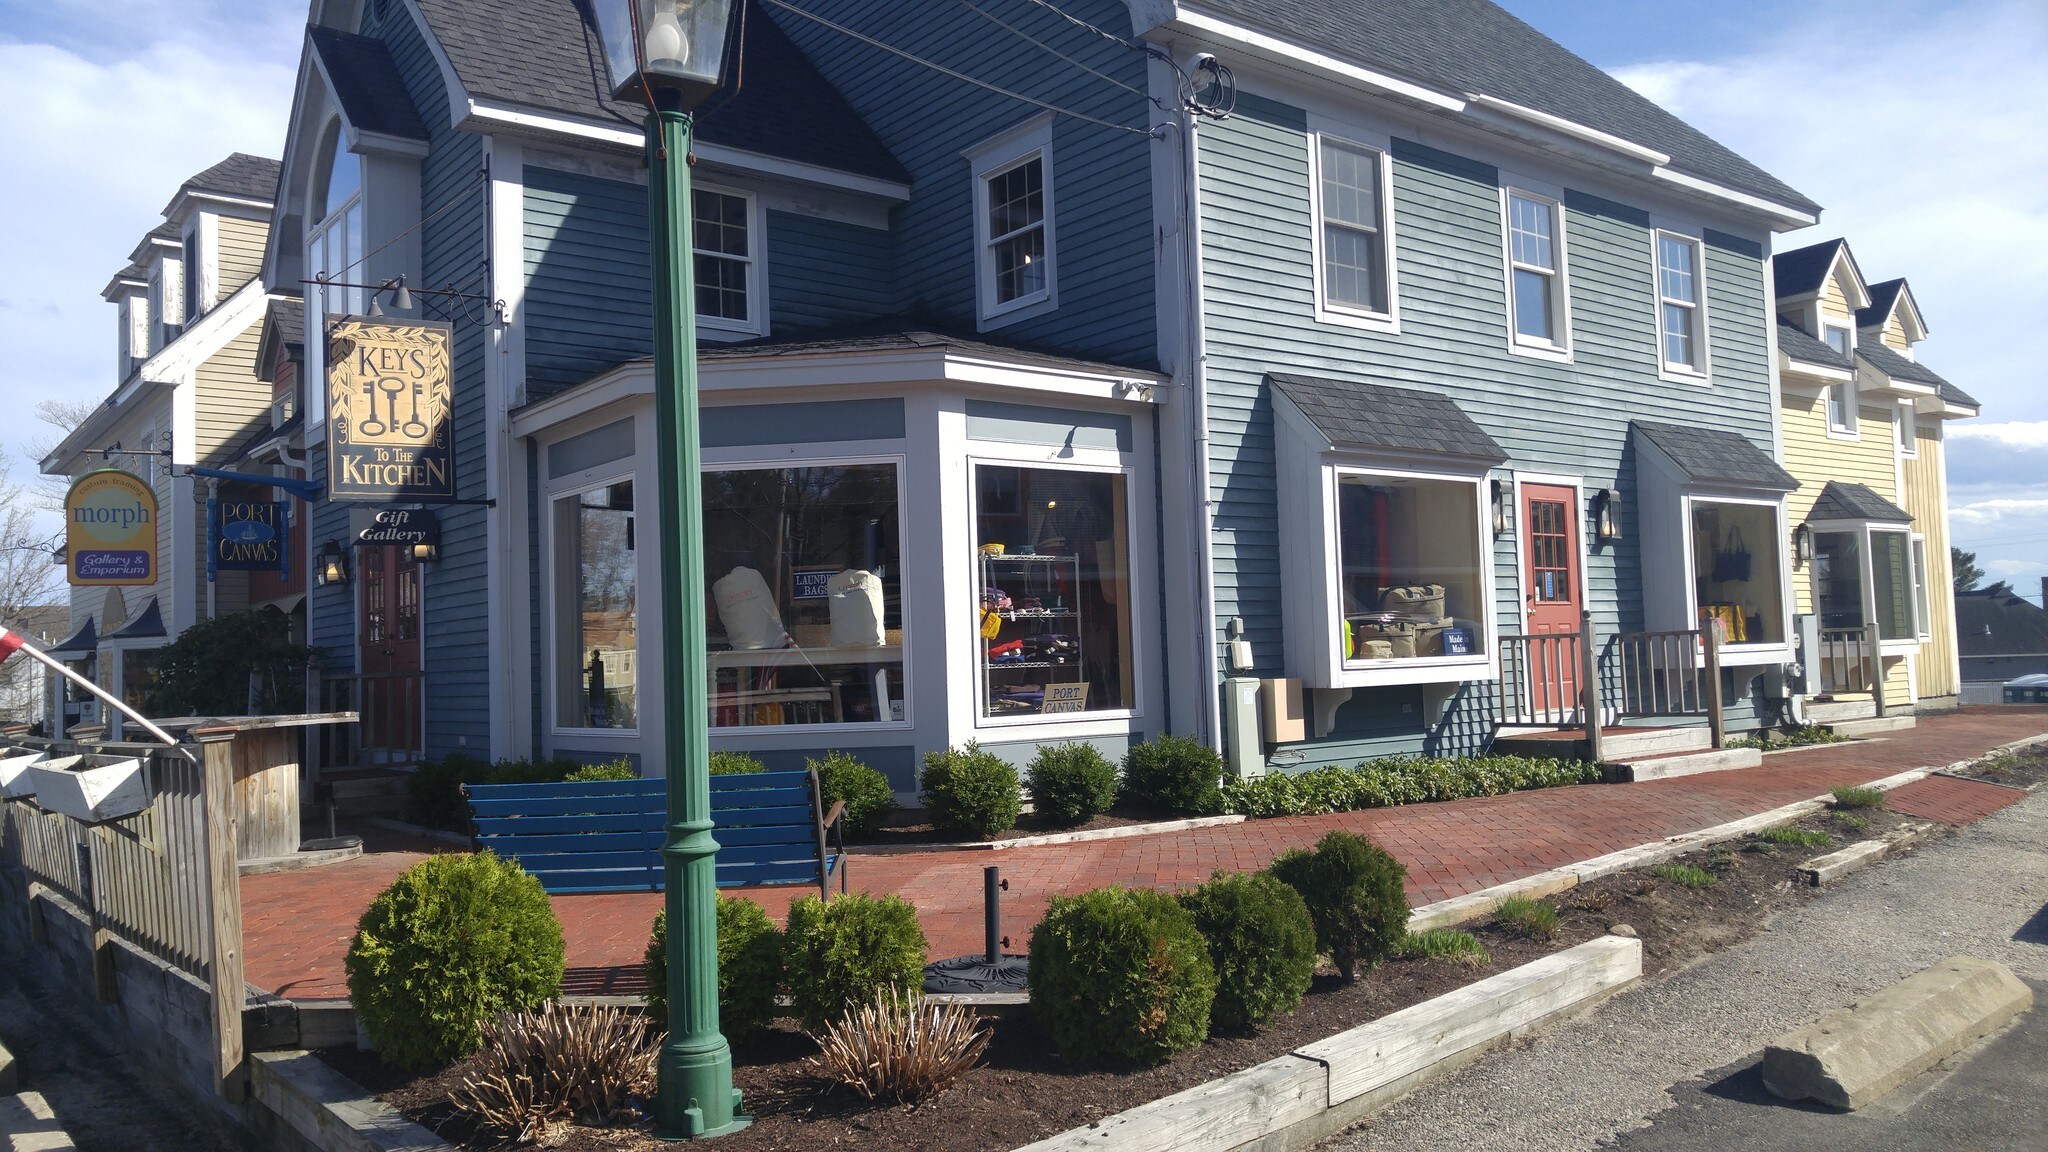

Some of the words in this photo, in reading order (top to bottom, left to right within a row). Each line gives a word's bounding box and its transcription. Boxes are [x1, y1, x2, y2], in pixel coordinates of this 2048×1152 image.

[358, 346, 426, 379] KEYS
[341, 454, 446, 486] KITCHEN
[80, 479, 108, 495] custom
[112, 478, 144, 497] framing
[73, 501, 150, 529] morph
[222, 503, 278, 528] PORT
[375, 510, 411, 526] Gift
[360, 527, 426, 544] Gallery
[220, 538, 278, 561] CANVAS
[84, 554, 131, 568] Gallery
[134, 556, 144, 564] &
[80, 564, 145, 576] Emporium
[796, 574, 832, 585] LAUNDR
[1449, 635, 1463, 643] Made
[1053, 688, 1080, 698] PORT
[1045, 701, 1082, 713] CANVAS
